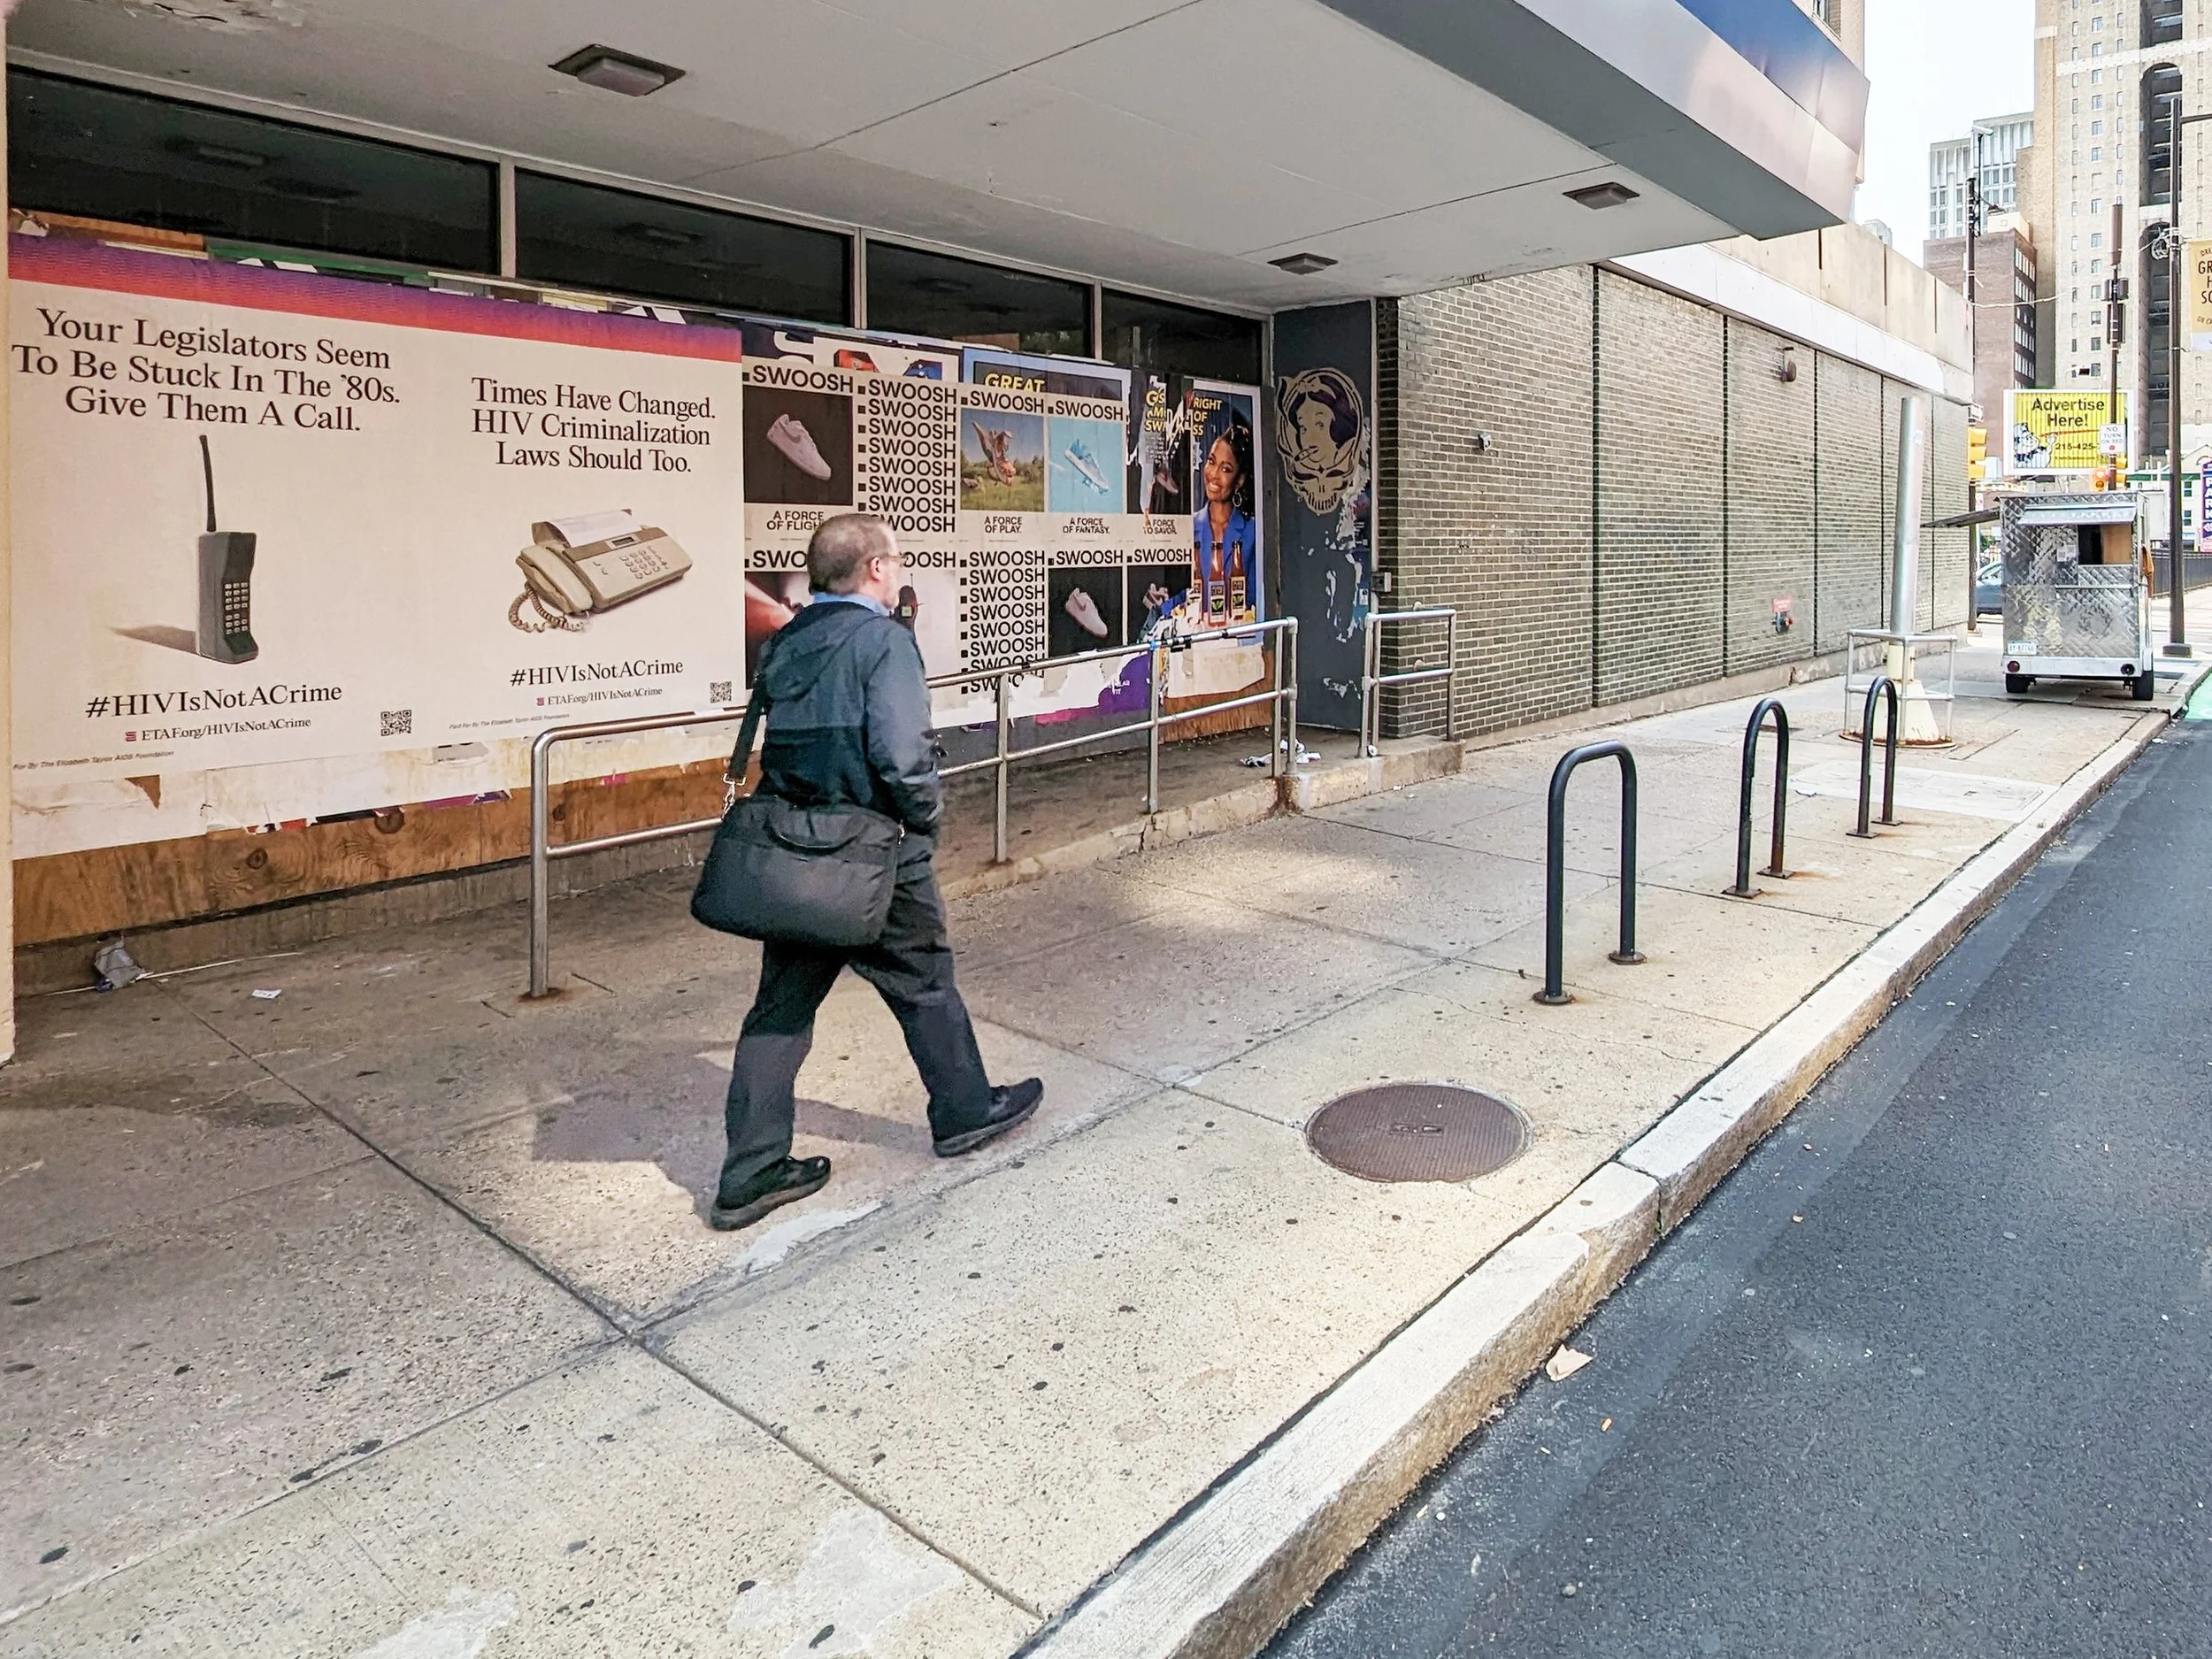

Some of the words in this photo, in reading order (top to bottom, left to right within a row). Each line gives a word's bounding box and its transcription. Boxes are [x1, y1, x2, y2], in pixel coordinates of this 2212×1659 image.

[37, 307, 123, 343] Your
[134, 319, 307, 362] Legislators
[316, 338, 390, 370] Seem
[12, 344, 58, 376] To
[70, 349, 117, 380] Be
[128, 356, 221, 390] Stuck
[230, 365, 264, 394] In
[274, 369, 332, 398] The
[65, 386, 147, 418] Give
[157, 392, 248, 425] Them
[257, 402, 285, 427] A
[294, 403, 361, 432] Call.
[472, 377, 547, 406] Times
[555, 384, 611, 411] Have
[618, 390, 716, 422] Changed.
[2032, 397, 2105, 411] Advertise
[472, 409, 534, 435] HIV
[541, 413, 711, 445] Criminalization
[2047, 413, 2088, 426] Here!
[495, 442, 560, 467] Laws
[568, 445, 642, 471] Should
[649, 449, 692, 472] Too.
[766, 520, 784, 530] OF
[772, 511, 782, 520] A
[785, 511, 825, 520] FORCE
[985, 525, 998, 534] OF
[993, 517, 1023, 526] FORCE
[1078, 518, 1103, 526] FORCE
[510, 659, 684, 687] #HIVIsNotACrime
[85, 684, 342, 718] #HIVIsNotACrime
